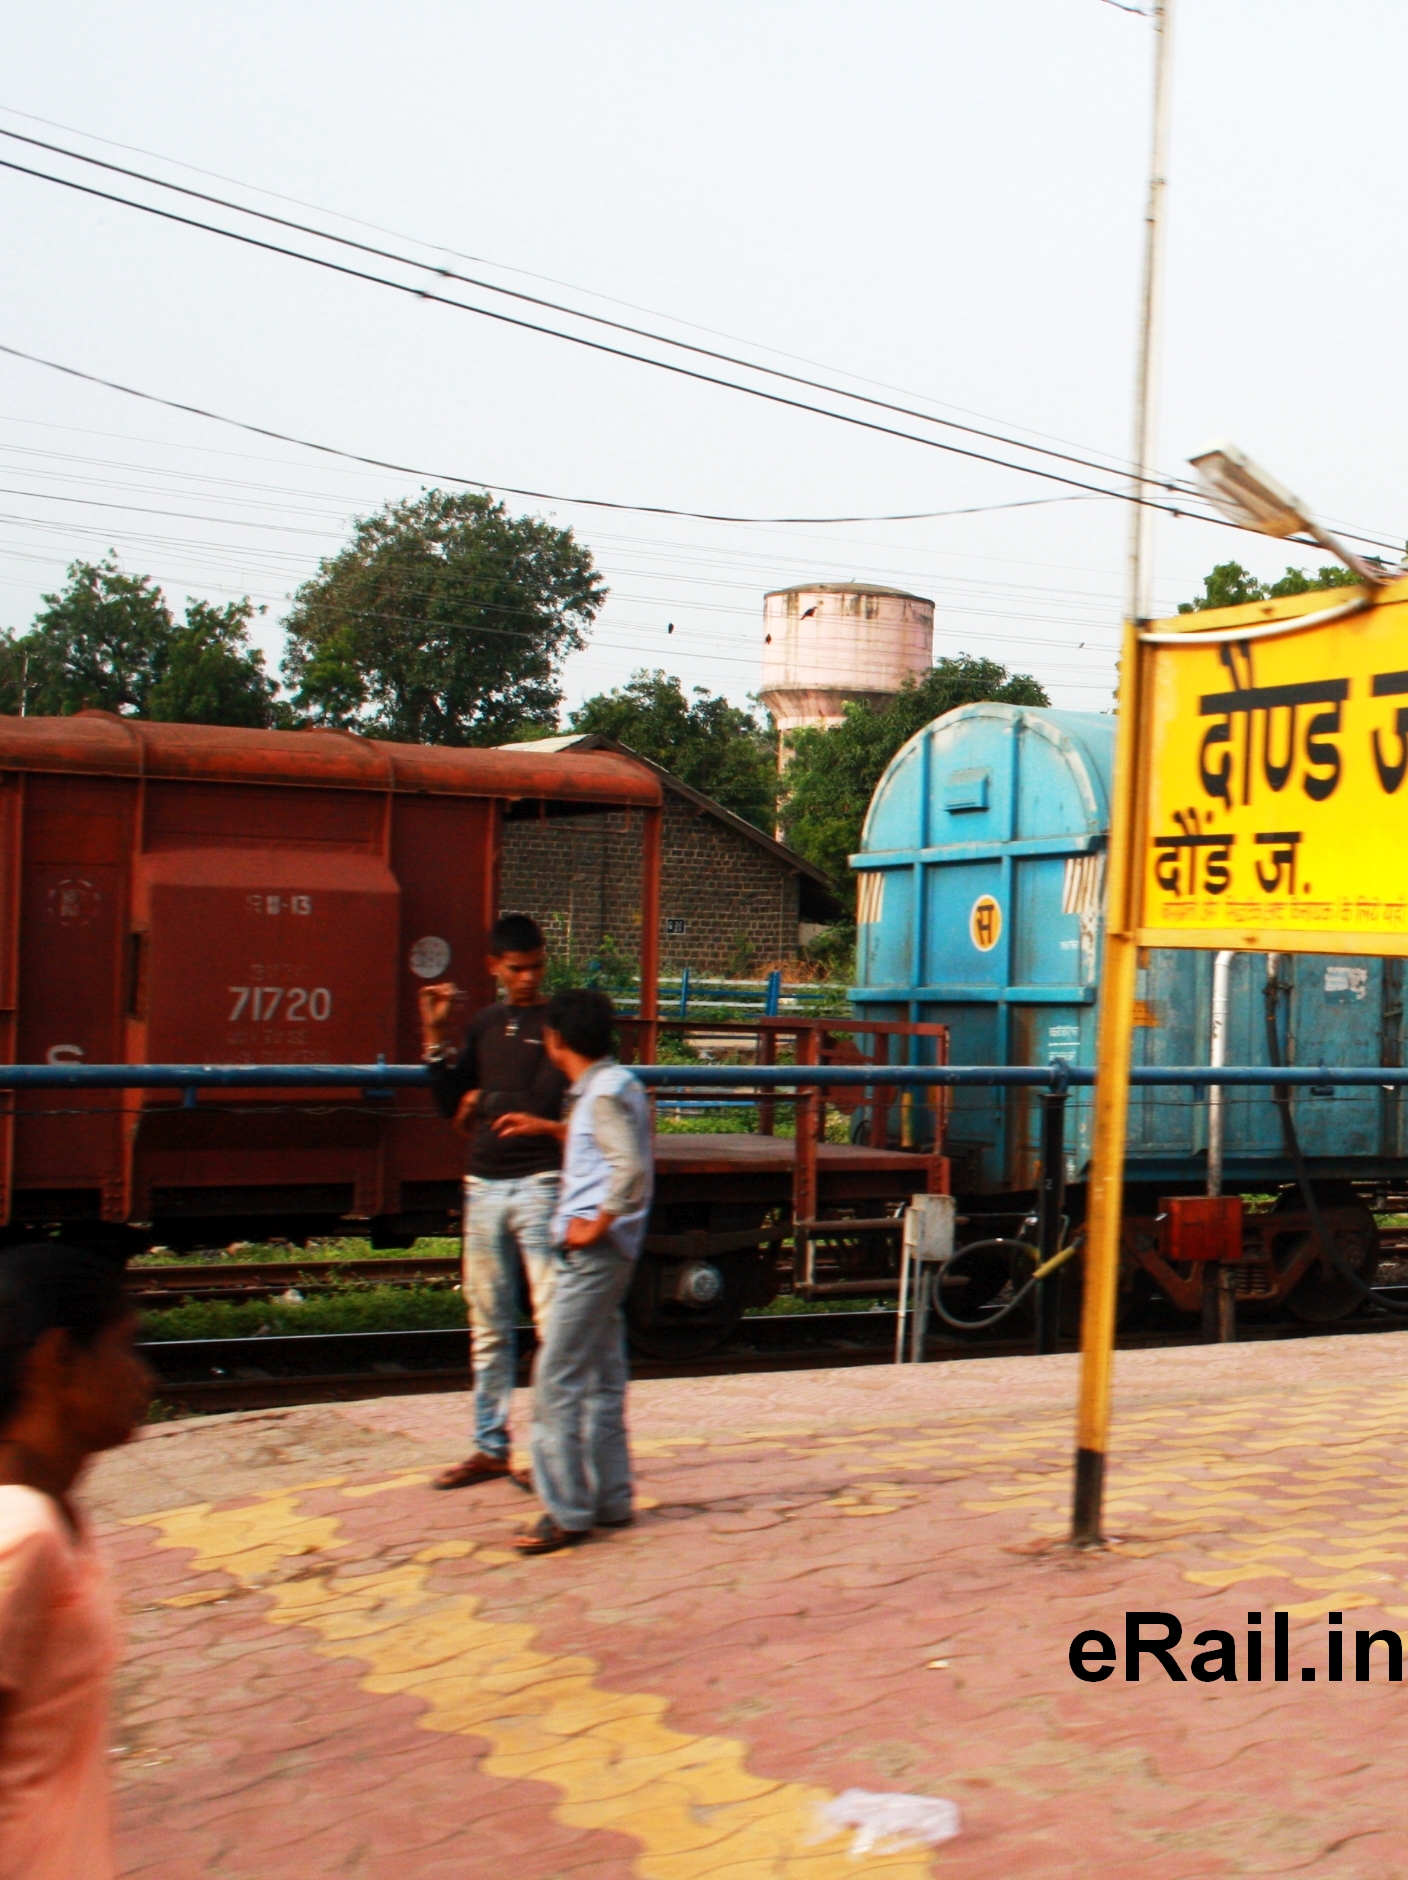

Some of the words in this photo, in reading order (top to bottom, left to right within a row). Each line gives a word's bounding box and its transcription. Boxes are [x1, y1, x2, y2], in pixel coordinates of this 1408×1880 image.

[1198, 639, 1351, 812] दौण्ड
[1154, 807, 1235, 897] दौंड
[1253, 831, 1311, 895] ज.
[228, 985, 333, 1021] 71720
